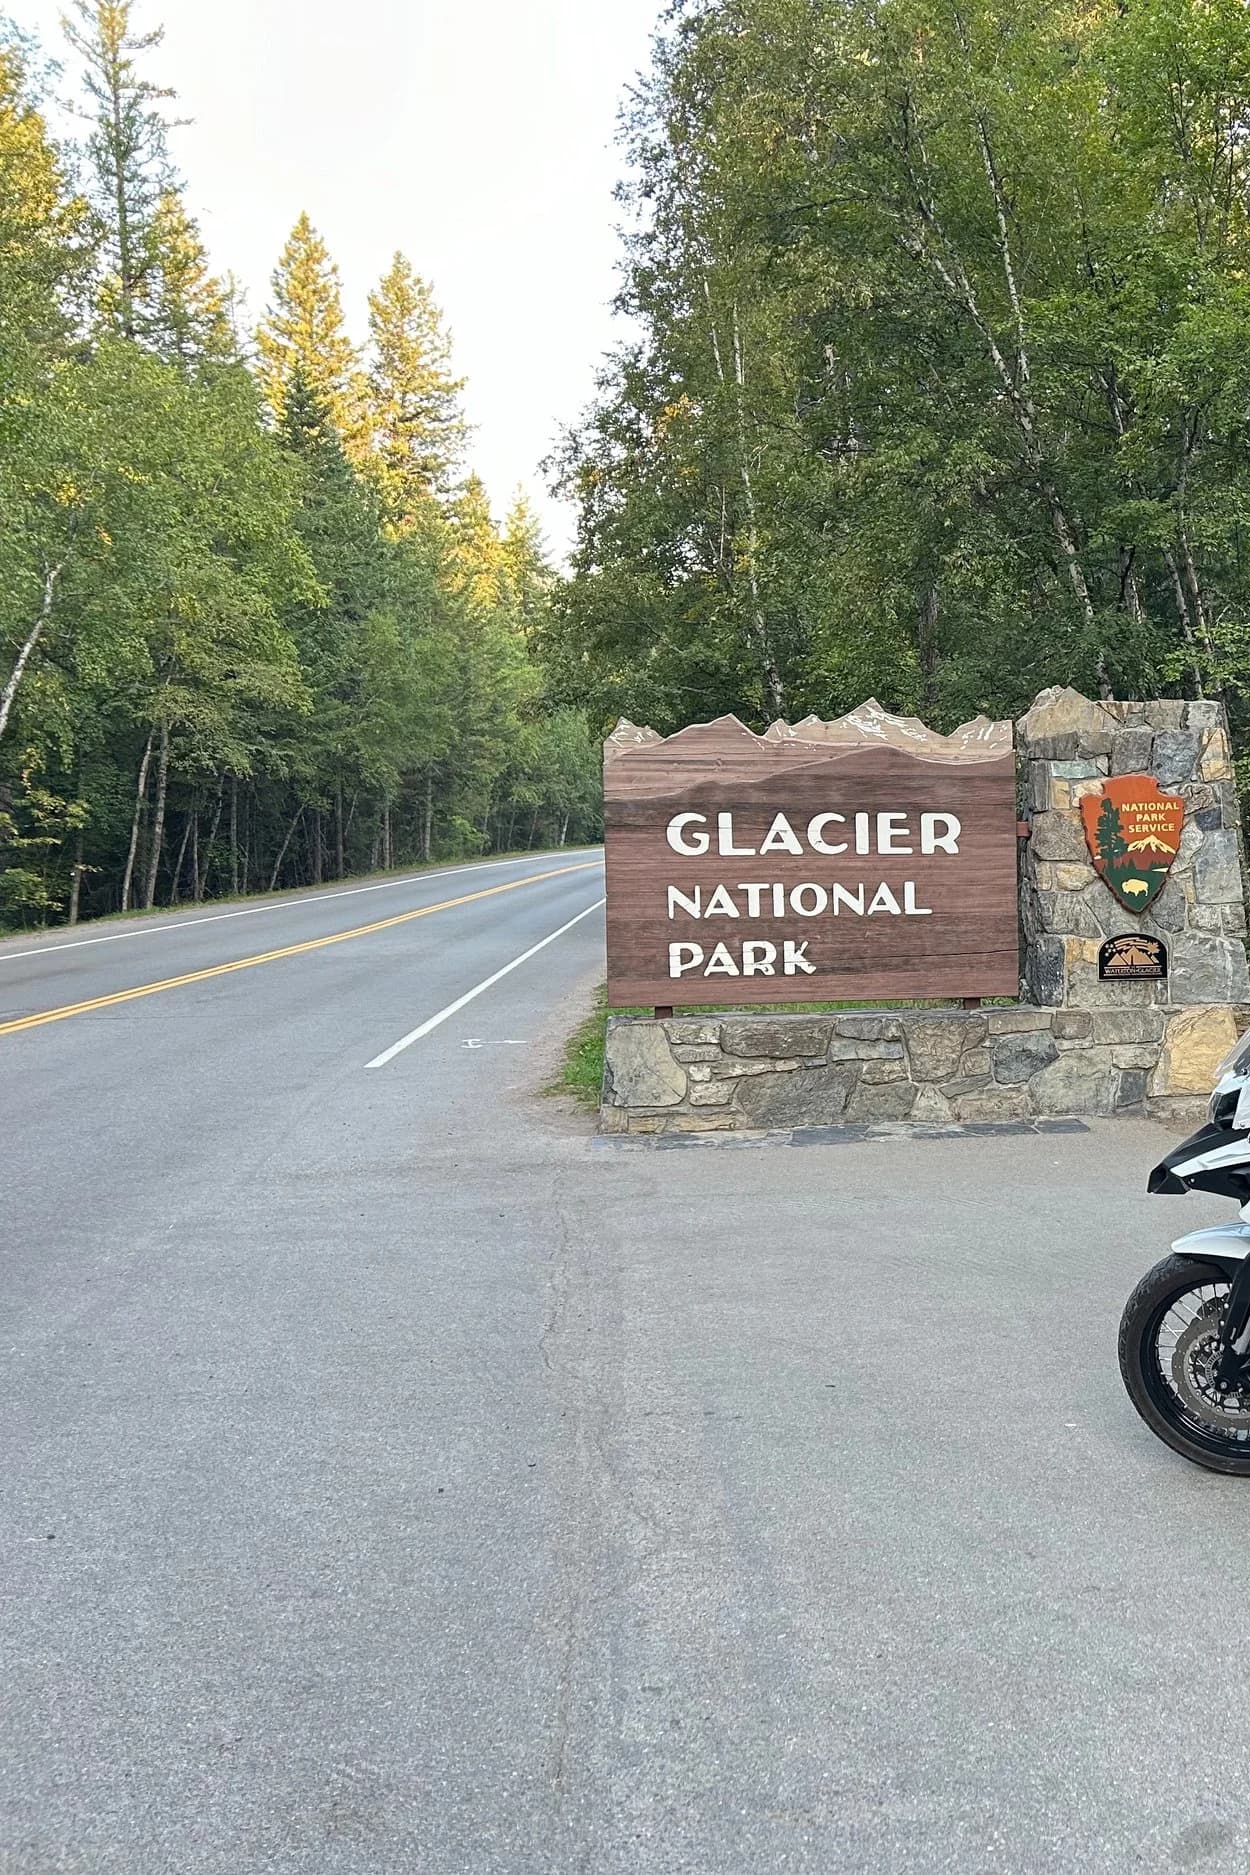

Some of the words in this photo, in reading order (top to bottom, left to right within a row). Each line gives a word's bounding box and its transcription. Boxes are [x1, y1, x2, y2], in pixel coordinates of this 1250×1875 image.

[1121, 802, 1180, 812] NATIONAL
[1136, 812, 1166, 822] PARK
[666, 812, 962, 856] GLACIER
[1128, 823, 1175, 833] SERVICE
[667, 881, 933, 920] NATIONAL
[668, 940, 817, 978] PARK
